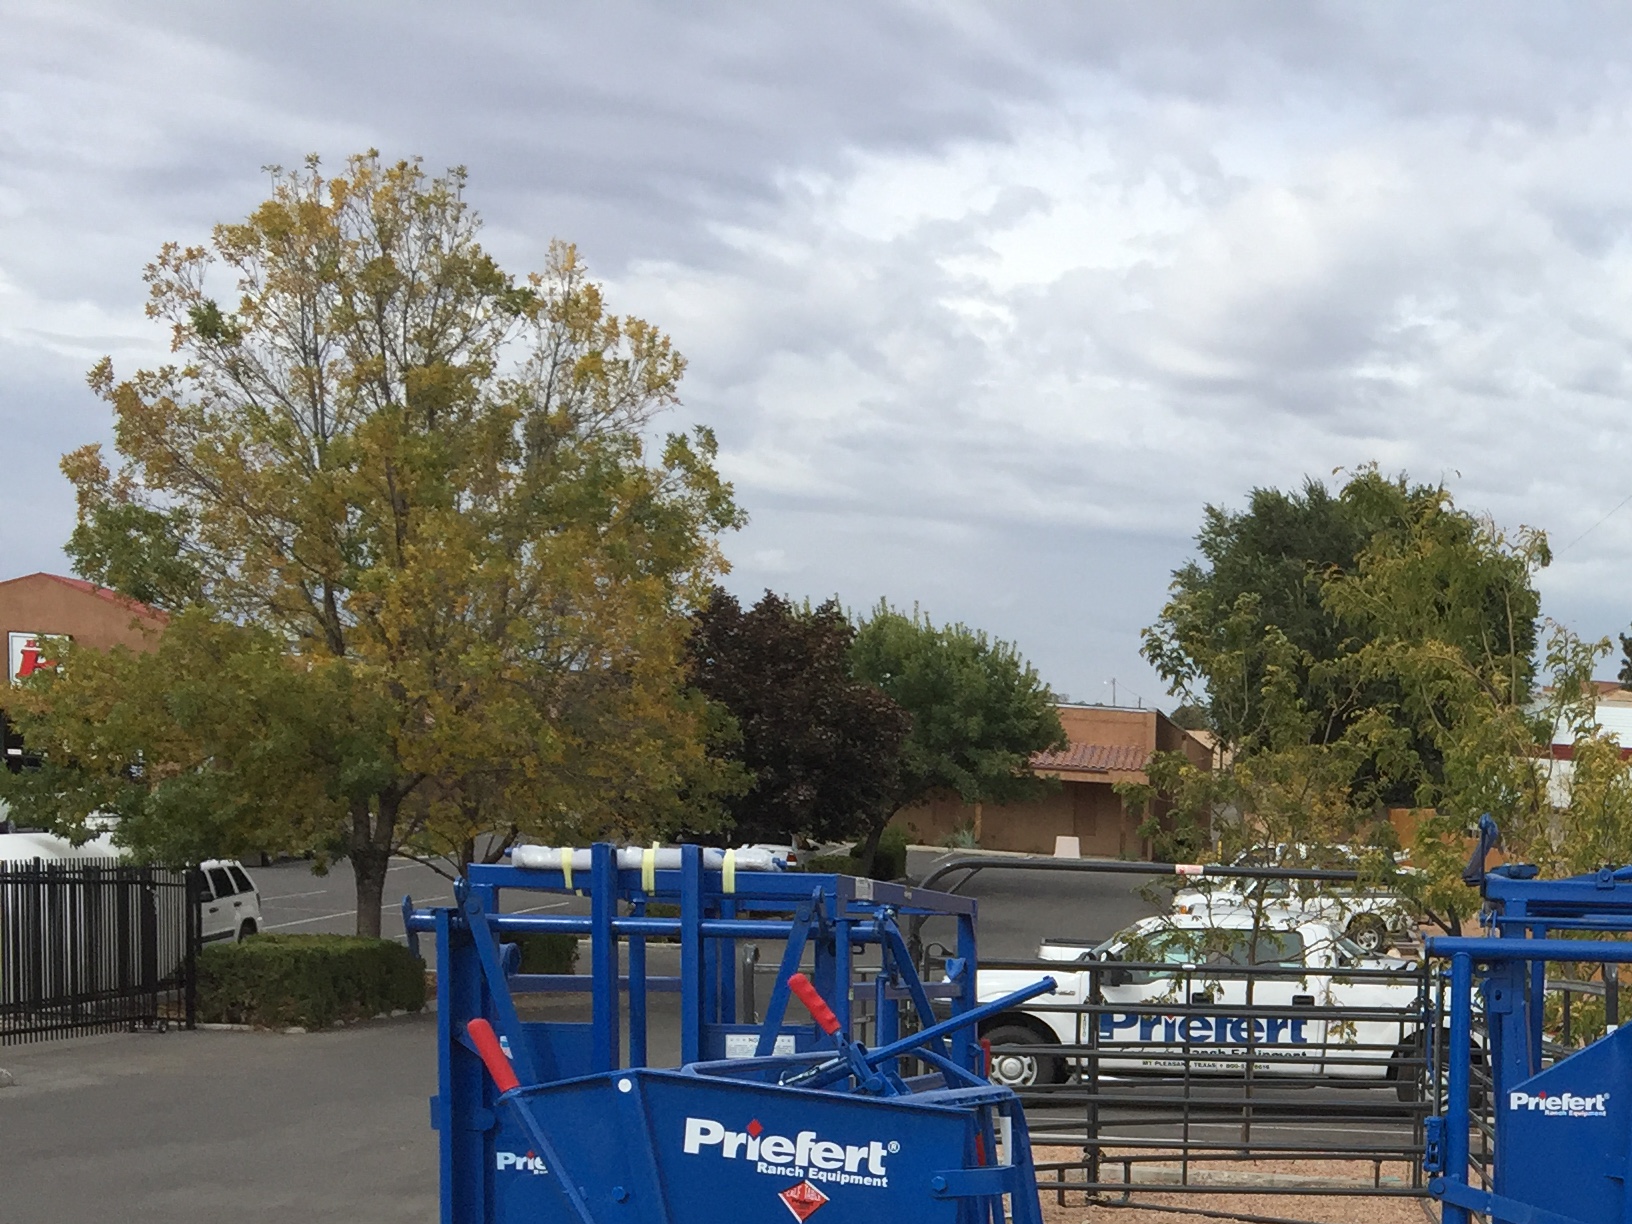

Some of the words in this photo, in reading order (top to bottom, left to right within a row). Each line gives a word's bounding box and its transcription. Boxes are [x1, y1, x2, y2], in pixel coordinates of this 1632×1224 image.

[1099, 1011, 1308, 1044] Priefert
[1509, 1091, 1605, 1111] Priefert
[683, 1117, 888, 1176] Priefert
[757, 1161, 804, 1178] Ranch
[808, 1167, 889, 1188] Equipment
